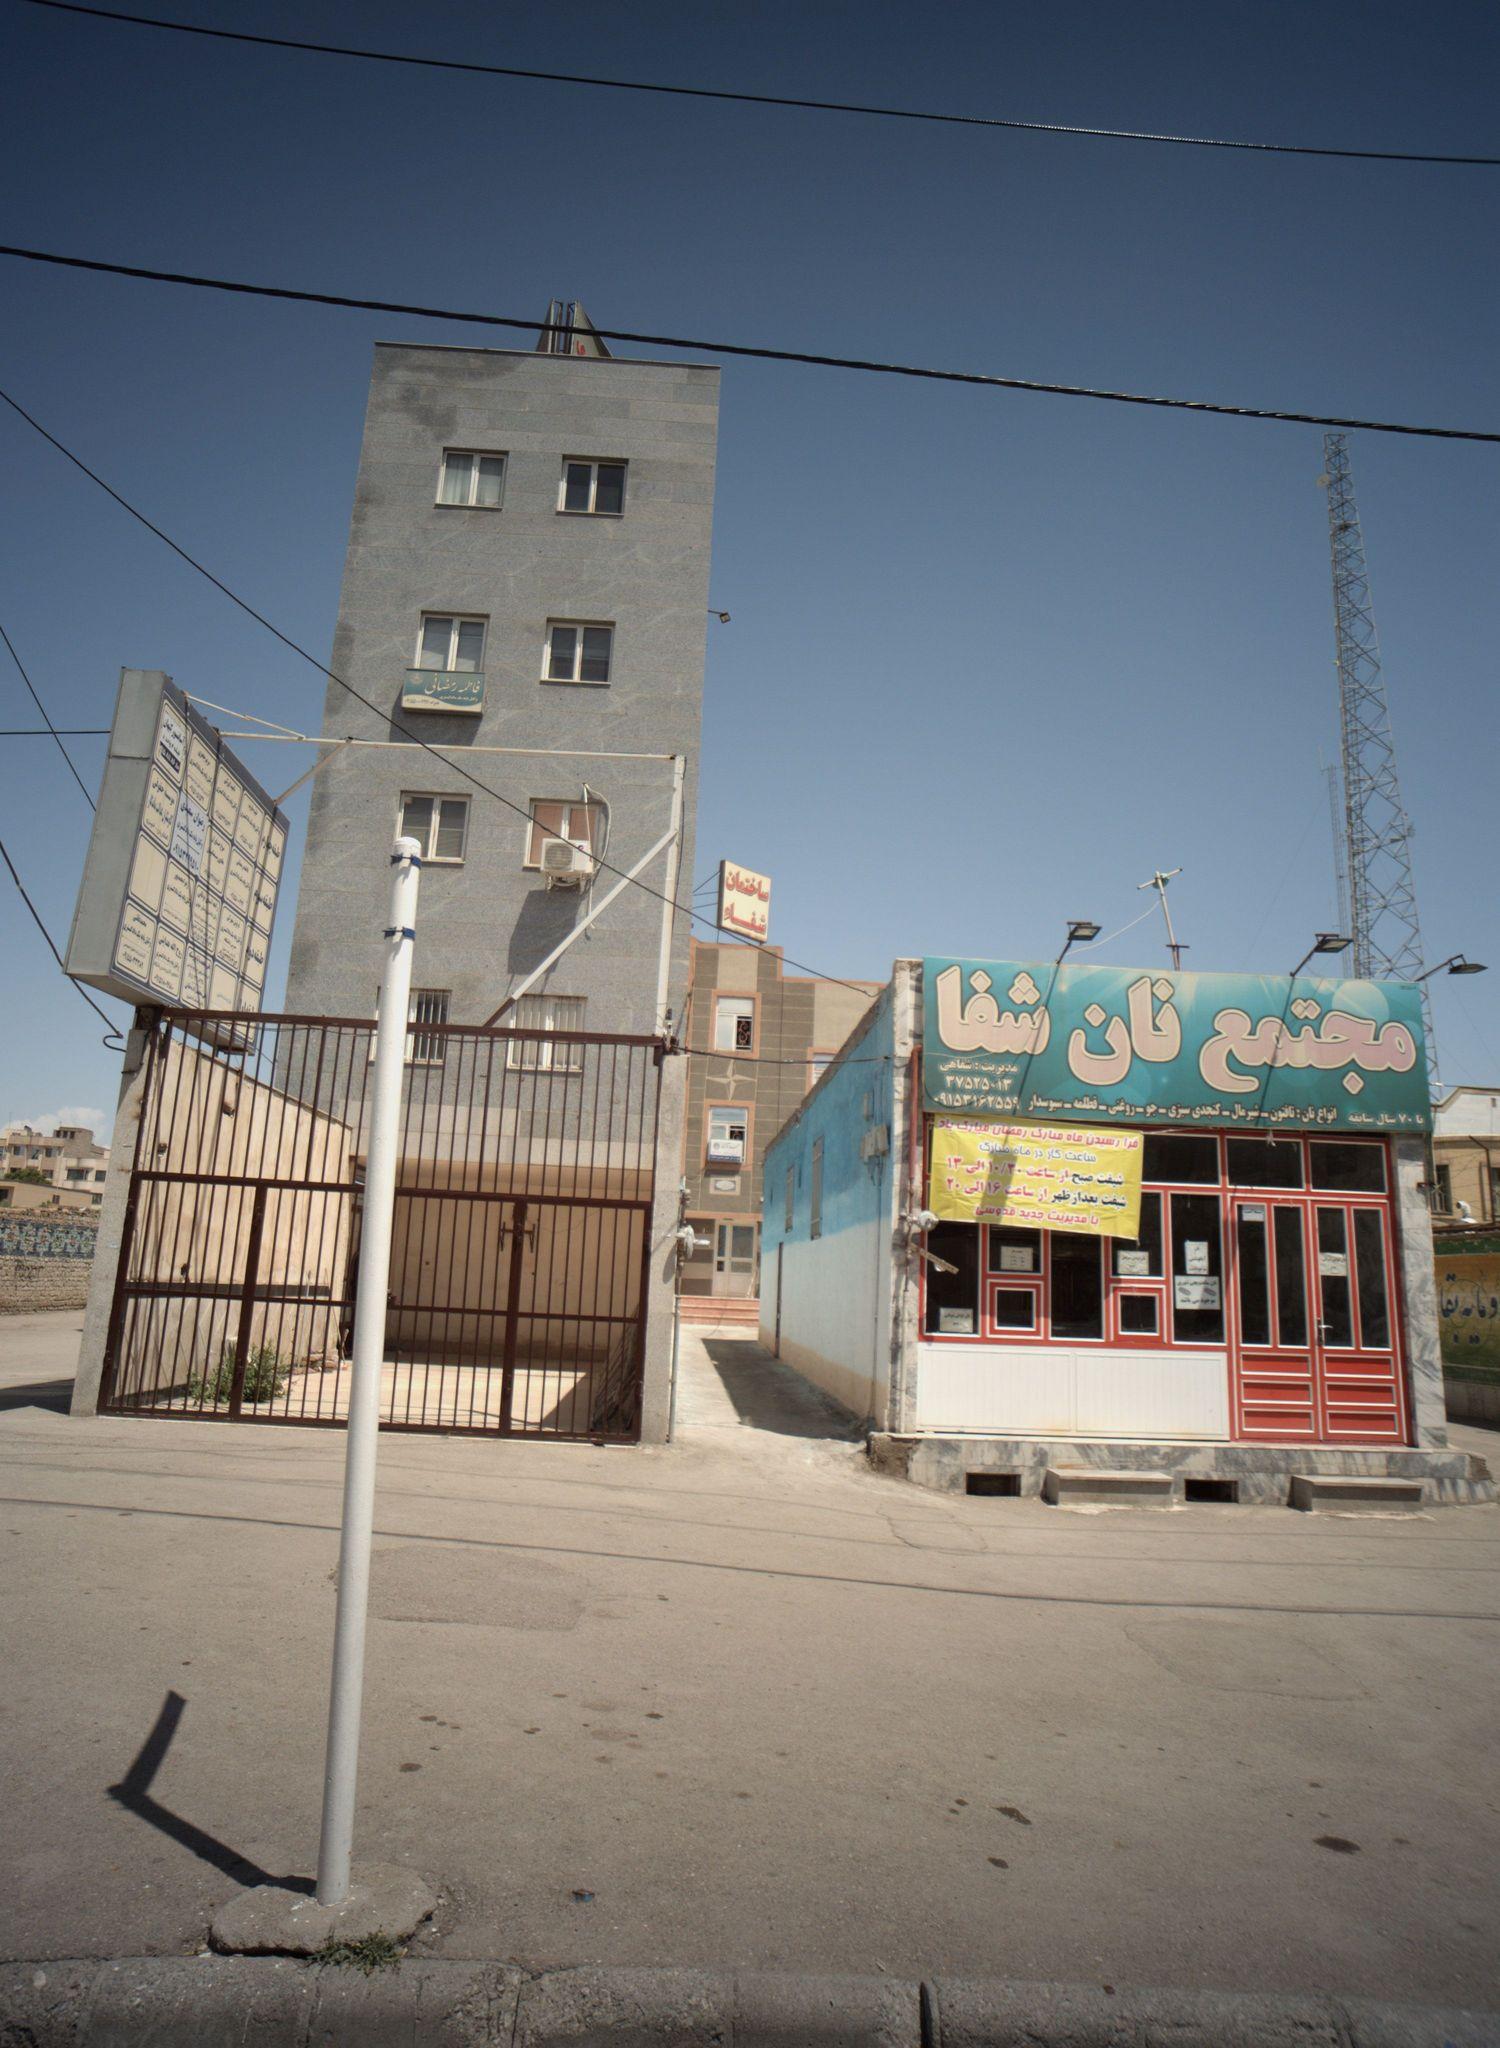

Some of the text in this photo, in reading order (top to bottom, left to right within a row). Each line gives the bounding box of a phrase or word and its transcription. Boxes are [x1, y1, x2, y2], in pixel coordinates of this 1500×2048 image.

[726, 870, 769, 902] ساختمان
[935, 965, 1417, 1096] مجتمع نان شفا
[981, 1061, 1018, 1075] مدیریت
[1108, 1098, 1135, 1115] روغنی
[1145, 1103, 1158, 1117] جو
[1168, 1104, 1190, 1118] سبزی
[1192, 1103, 1221, 1118] کنجدی
[1317, 1104, 1337, 1123] انواع
[1301, 1106, 1315, 1122] نان
[1376, 1112, 1396, 1126] سال
[1399, 1113, 1412, 1124] ۷۰
[957, 1120, 990, 1134] مبارک
[993, 1123, 1028, 1138] رمضان
[1031, 1128, 1064, 1142] مبارک
[1066, 1133, 1083, 1143] ماه
[1086, 1134, 1120, 1147] رسیدن
[1123, 1136, 1139, 1149] فرا
[979, 1141, 1096, 1163] ساعت کار در ماه مبارک
[965, 1160, 985, 1174] الی
[1026, 1166, 1056, 1179] ساعت
[946, 1177, 960, 1190] ۲۰
[1058, 1170, 1069, 1183] از
[1071, 1171, 1093, 1185] صبح
[1097, 1173, 1124, 1187] شیفت
[964, 1179, 984, 1195] الی
[987, 1179, 1001, 1194] ۱۶
[1005, 1185, 1034, 1198] ساعت
[1038, 1188, 1047, 1202] از
[1101, 1193, 1127, 1209] شیفت
[976, 1204, 1098, 1225] با مدیریت جدید قدوسی
